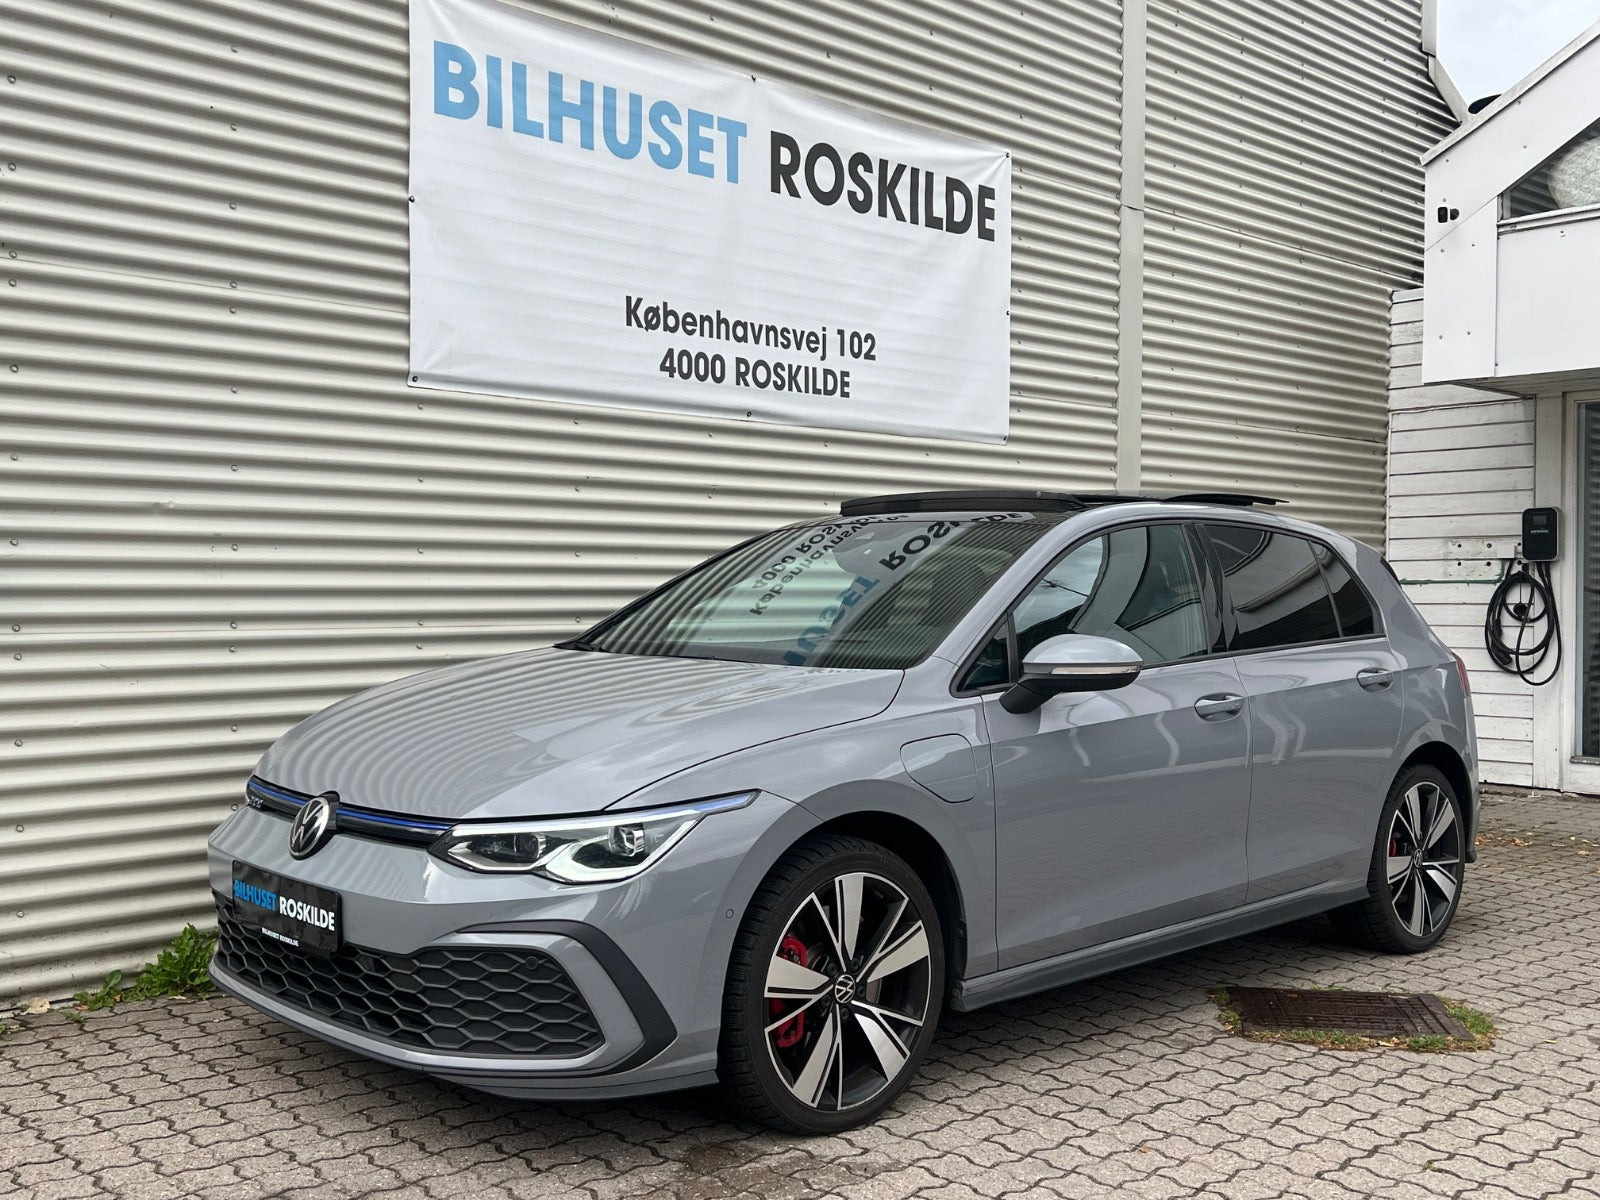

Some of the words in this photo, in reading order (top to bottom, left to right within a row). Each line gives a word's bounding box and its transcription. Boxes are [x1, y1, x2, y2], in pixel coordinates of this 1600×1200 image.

[433, 40, 748, 185] BILHUSET
[769, 130, 996, 243] ROSKILDE
[625, 295, 828, 362] Københavnsvej
[836, 328, 877, 361] 102
[659, 347, 726, 385] 4000
[735, 356, 851, 399] ROSKILDE
[233, 879, 277, 911] BILHUSET
[279, 896, 335, 931] ROSKILDE
